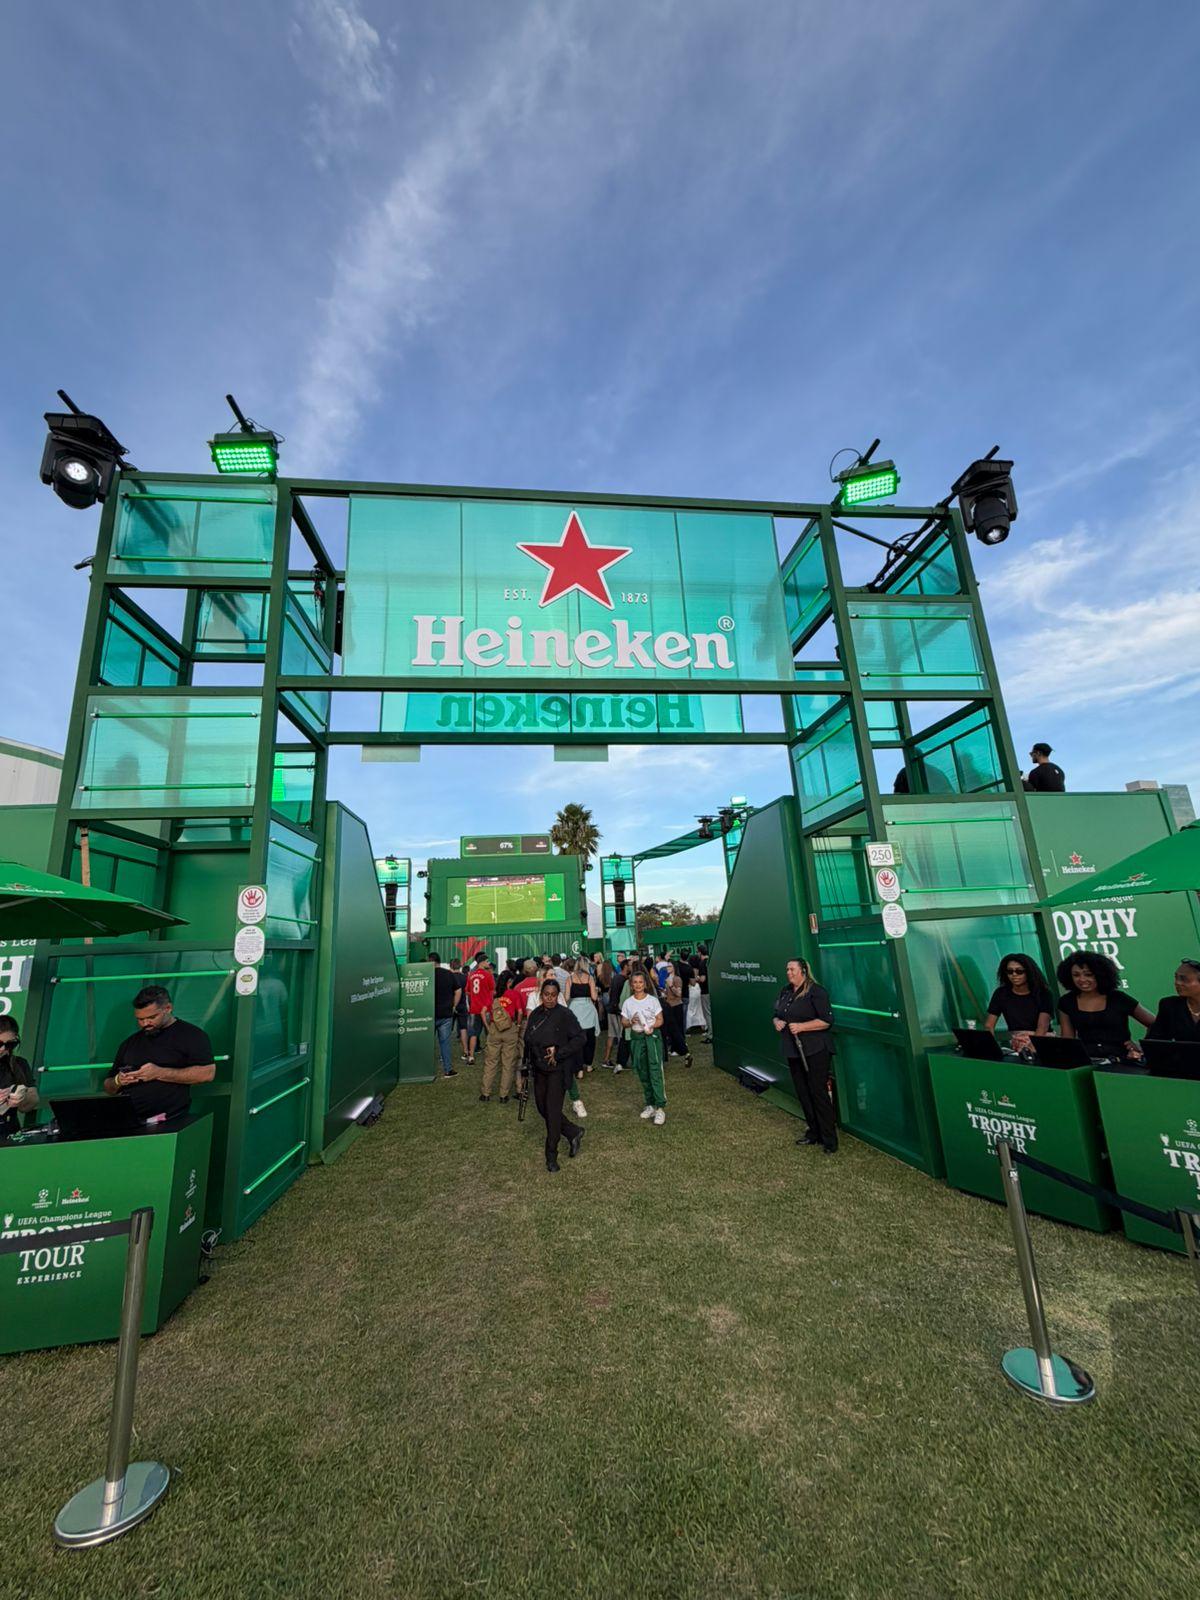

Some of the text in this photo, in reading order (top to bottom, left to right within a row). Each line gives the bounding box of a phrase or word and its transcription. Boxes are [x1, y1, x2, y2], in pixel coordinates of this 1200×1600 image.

[503, 588, 648, 605] EST. 1873
[870, 848, 892, 861] 250
[1061, 865, 1096, 874] Heineken
[473, 978, 480, 994] 8
[967, 1113, 1037, 1141] TROPHY
[1175, 1140, 1196, 1150] UEFA
[18, 1210, 112, 1226] UEFA Champions League
[19, 1244, 85, 1272] TOUR
[16, 1270, 82, 1285] EXPERIENCE
